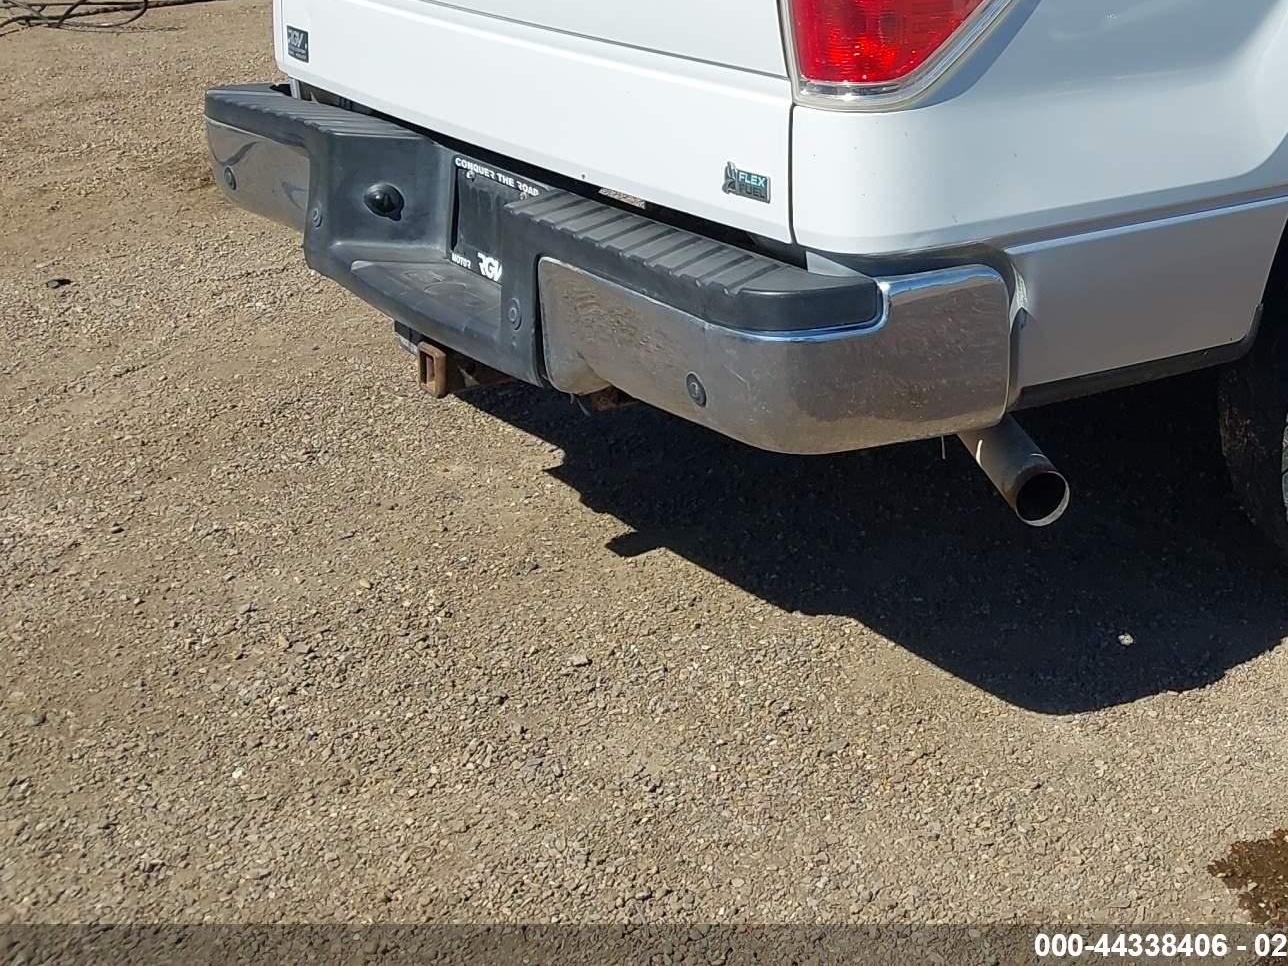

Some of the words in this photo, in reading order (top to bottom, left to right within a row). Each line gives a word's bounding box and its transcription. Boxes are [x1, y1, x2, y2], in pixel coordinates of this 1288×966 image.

[455, 157, 495, 180] CONQUER
[496, 172, 515, 187] THE
[516, 180, 539, 197] ROAD
[738, 171, 766, 187] FLEX
[738, 182, 766, 199] FUEL
[451, 252, 472, 269] MOTOR
